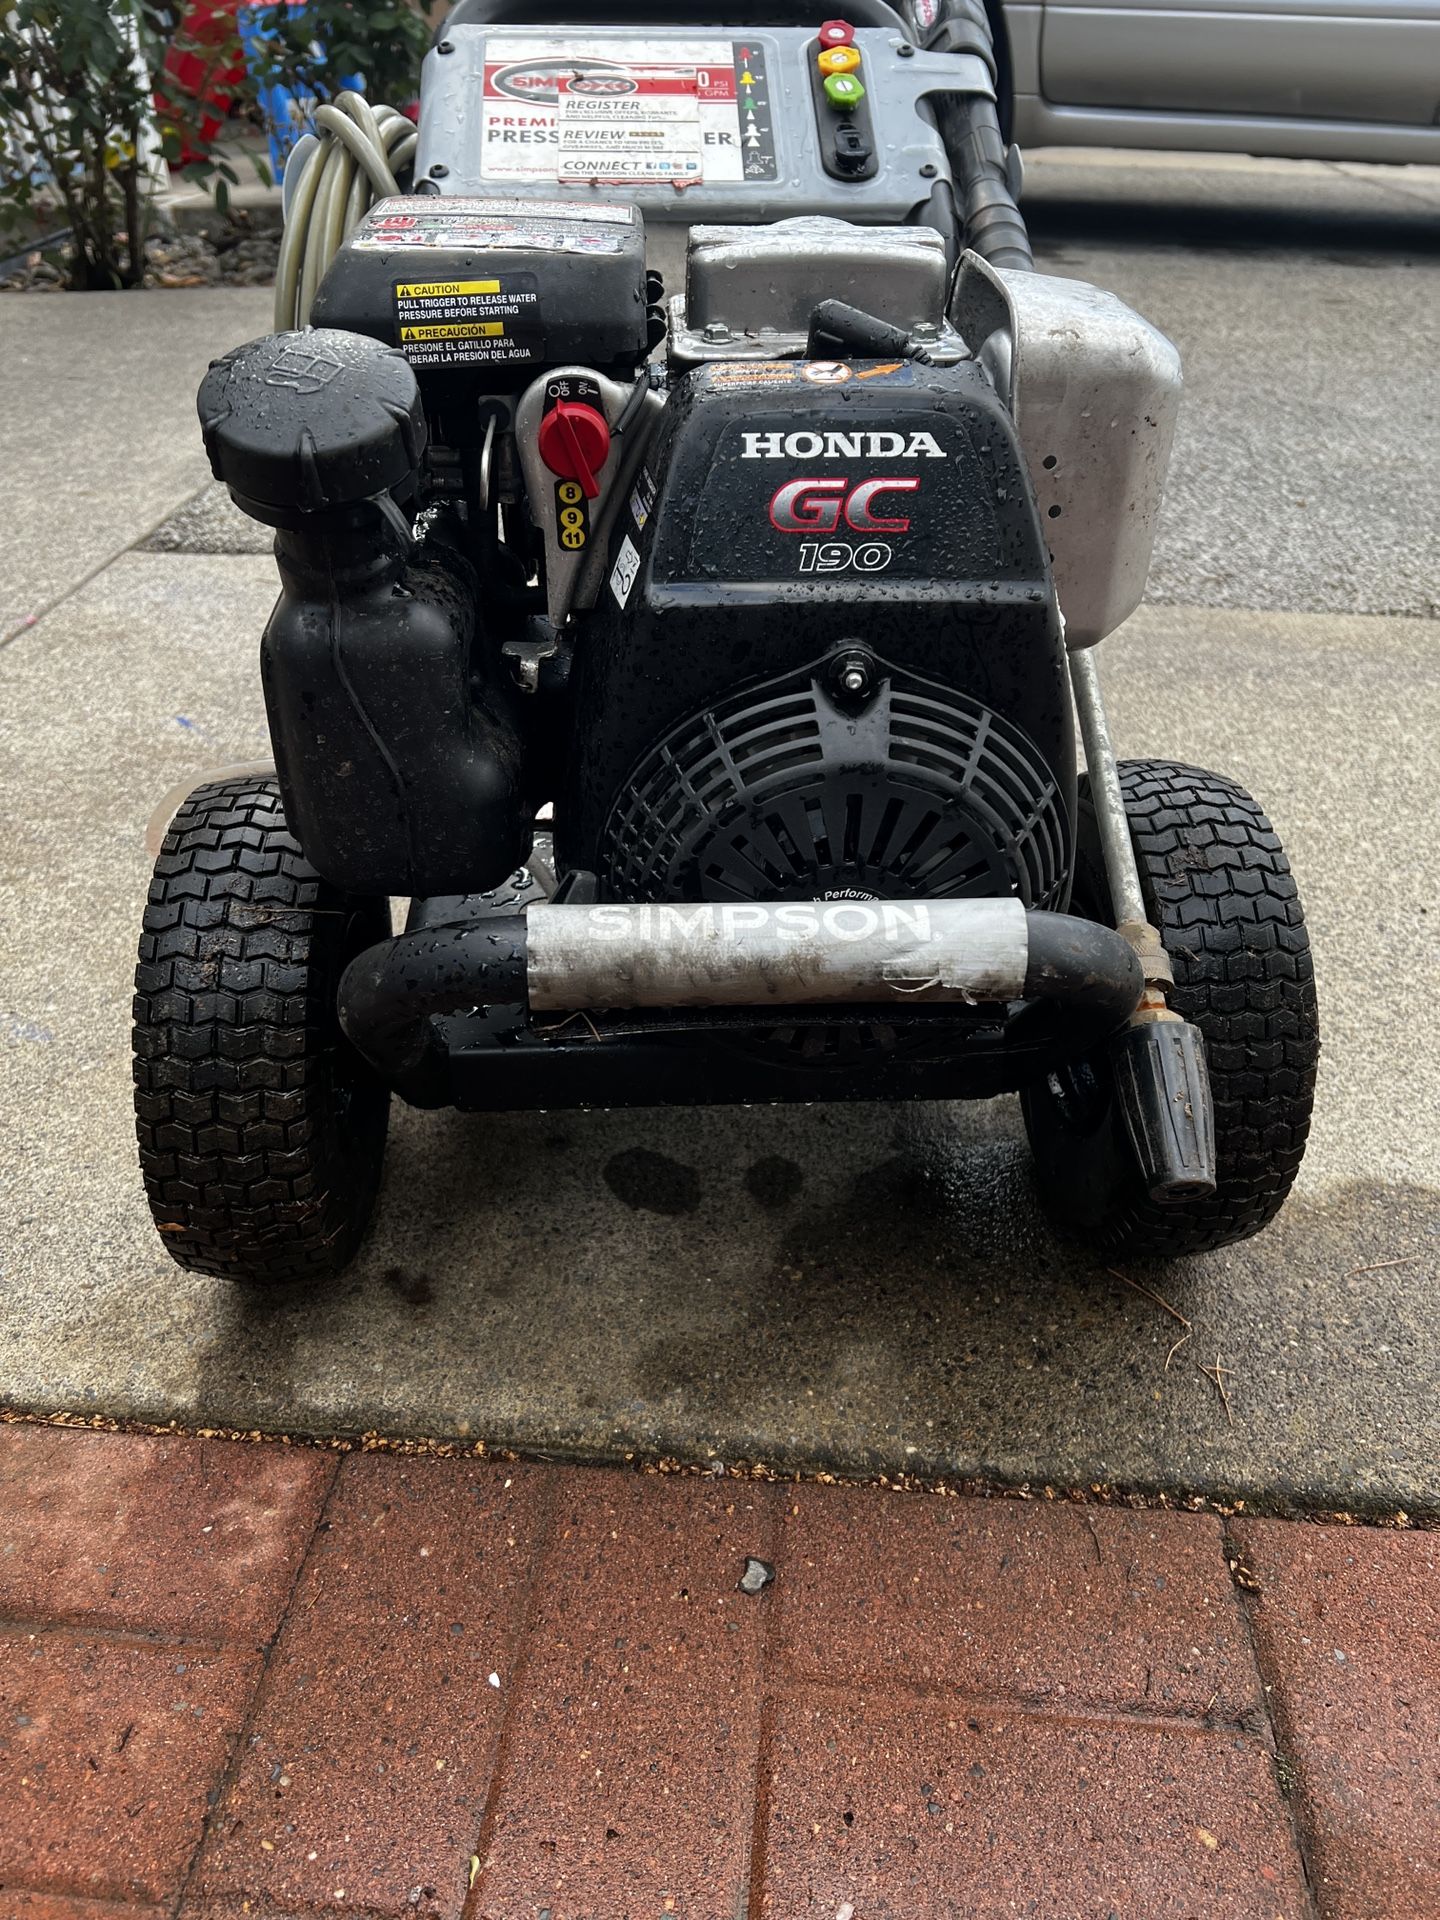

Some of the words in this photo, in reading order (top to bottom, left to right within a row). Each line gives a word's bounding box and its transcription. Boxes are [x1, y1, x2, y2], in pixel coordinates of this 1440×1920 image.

[511, 76, 558, 88] SIM
[704, 89, 729, 97] GPM
[566, 100, 641, 110] REGISTER
[489, 117, 559, 127] PREMI
[564, 130, 626, 140] REVIEW
[563, 161, 642, 171] CONNECT
[413, 284, 460, 296] CAUTION
[397, 299, 420, 310] PULL
[420, 297, 457, 308] TRIGGER
[457, 296, 469, 306] TO
[470, 295, 508, 306] RELEASE
[508, 293, 537, 304] WATER
[399, 309, 443, 320] PRESSURE
[444, 307, 478, 318] BEFORE
[479, 305, 519, 316] STARTING
[418, 323, 486, 338] PRECAUCIÓN
[403, 342, 445, 353] PRESIONE
[445, 341, 457, 352] EL
[457, 339, 492, 350] GATILLO
[493, 338, 515, 349] PARA
[409, 352, 440, 364] IBERAR
[441, 352, 453, 363] LA
[454, 350, 490, 361] PRESIÓN
[490, 349, 507, 359] DEL
[508, 348, 532, 359] AGUA
[560, 380, 570, 397] OFF
[578, 381, 588, 396] ON
[741, 431, 947, 459] HONDA
[565, 486, 576, 499] 8
[769, 477, 921, 533] GC
[567, 511, 578, 524] 9
[565, 532, 581, 545] 11
[799, 542, 892, 572] 190
[587, 903, 932, 943] SIMPSON
